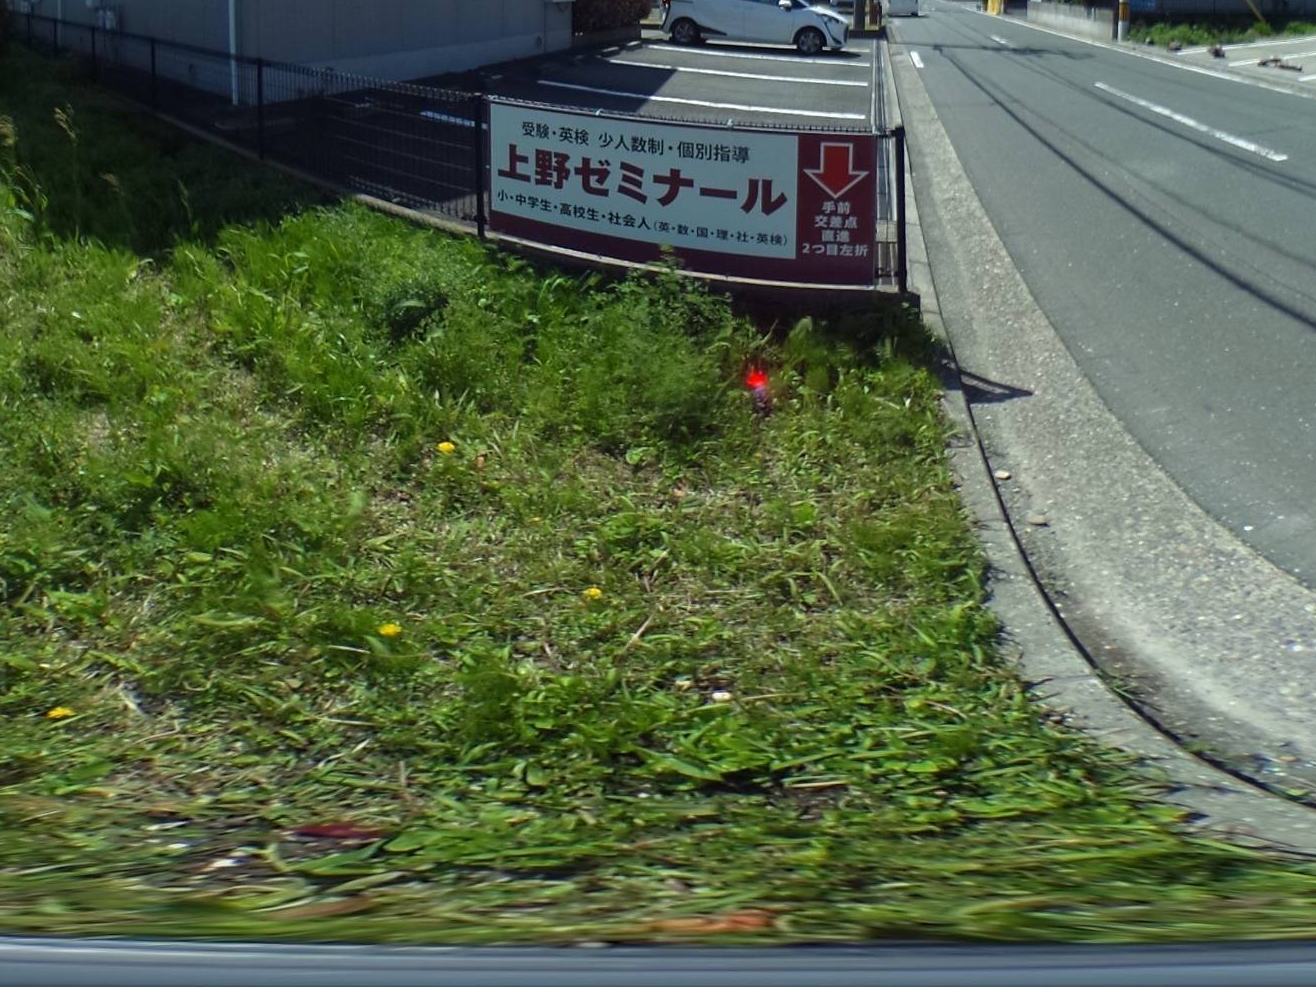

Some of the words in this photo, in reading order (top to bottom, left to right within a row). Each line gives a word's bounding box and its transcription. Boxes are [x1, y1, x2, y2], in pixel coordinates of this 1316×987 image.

[522, 121, 589, 146] 受験・英検
[598, 132, 750, 163] 少人数制・個別指導
[498, 143, 787, 215] 上野ゼミナール
[822, 200, 850, 214] 手前
[814, 215, 857, 229] 交差点
[821, 229, 850, 243] 直進
[802, 243, 868, 257] 2つ目左折
